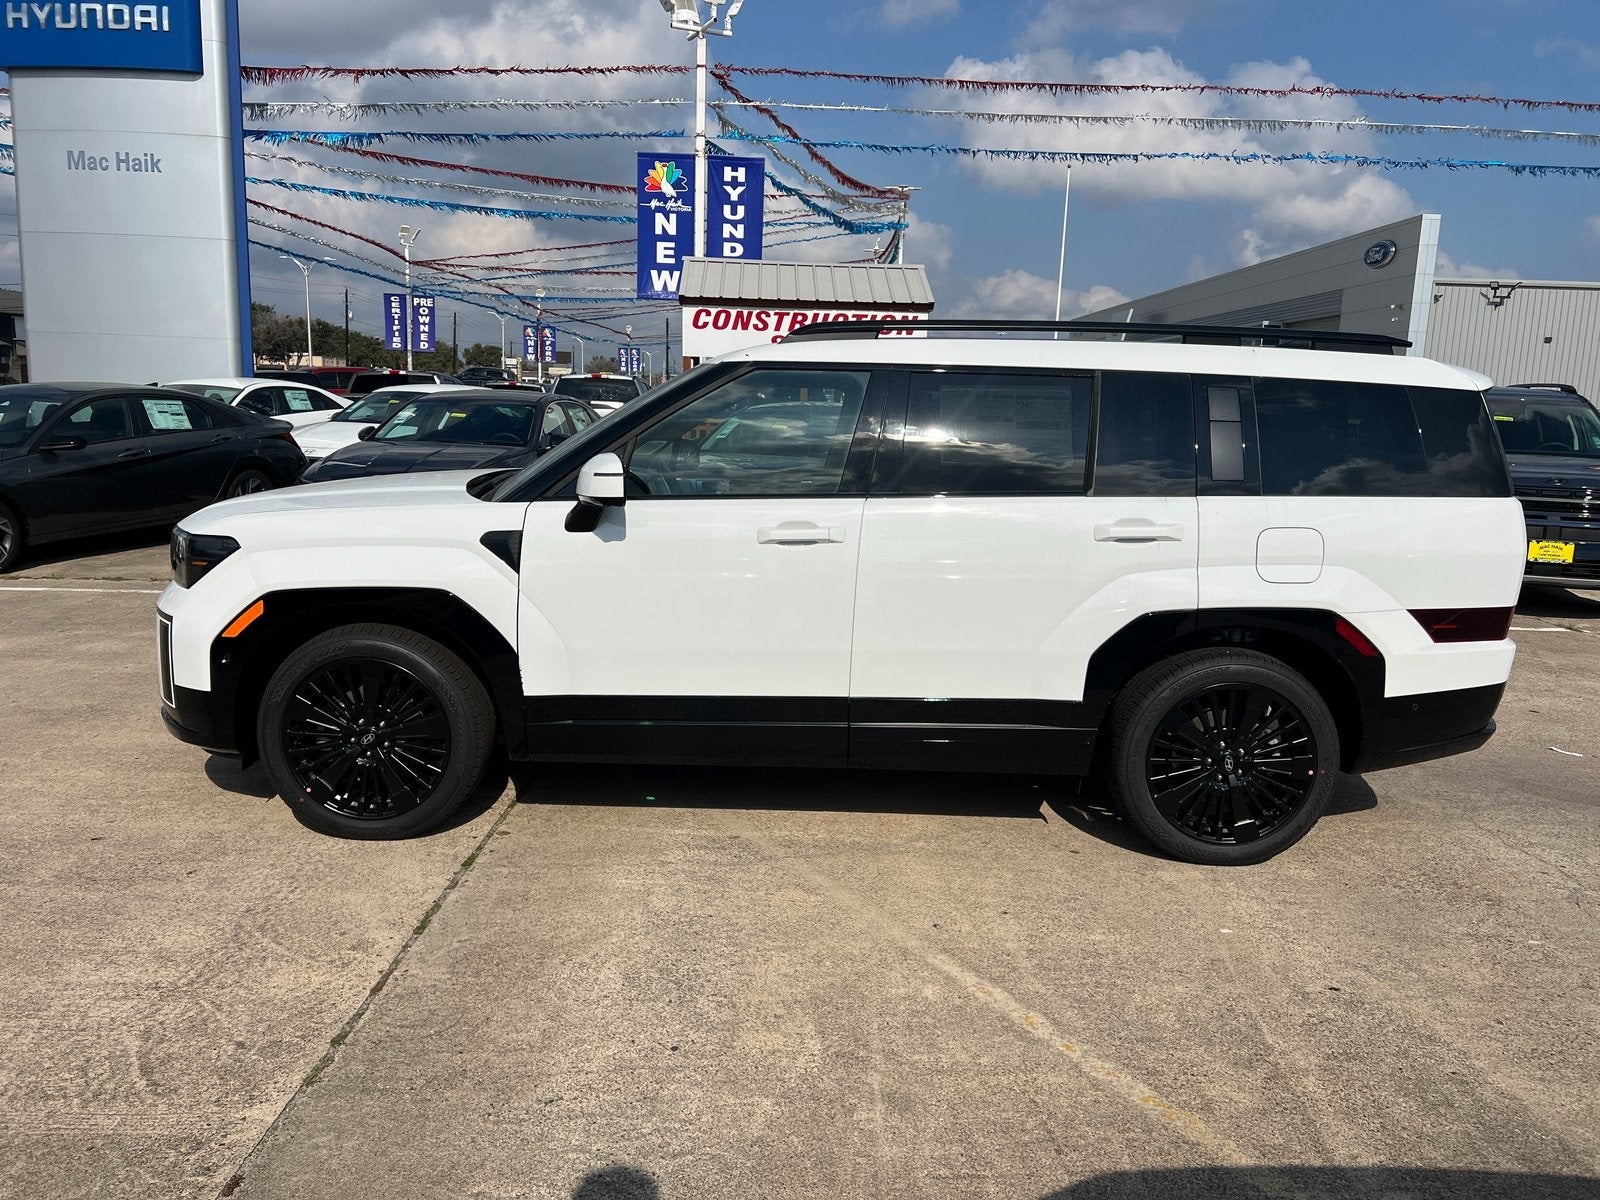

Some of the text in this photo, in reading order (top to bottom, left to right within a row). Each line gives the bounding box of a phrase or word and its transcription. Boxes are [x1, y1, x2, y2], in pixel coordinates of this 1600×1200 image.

[6, 2, 170, 32] HYUNDAI
[66, 150, 162, 173] Mac Haik
[650, 212, 680, 292] NEW
[413, 298, 434, 306] PRE
[390, 296, 401, 348] CERTIFIED
[418, 307, 430, 349] OWNED
[526, 340, 536, 361] NEW
